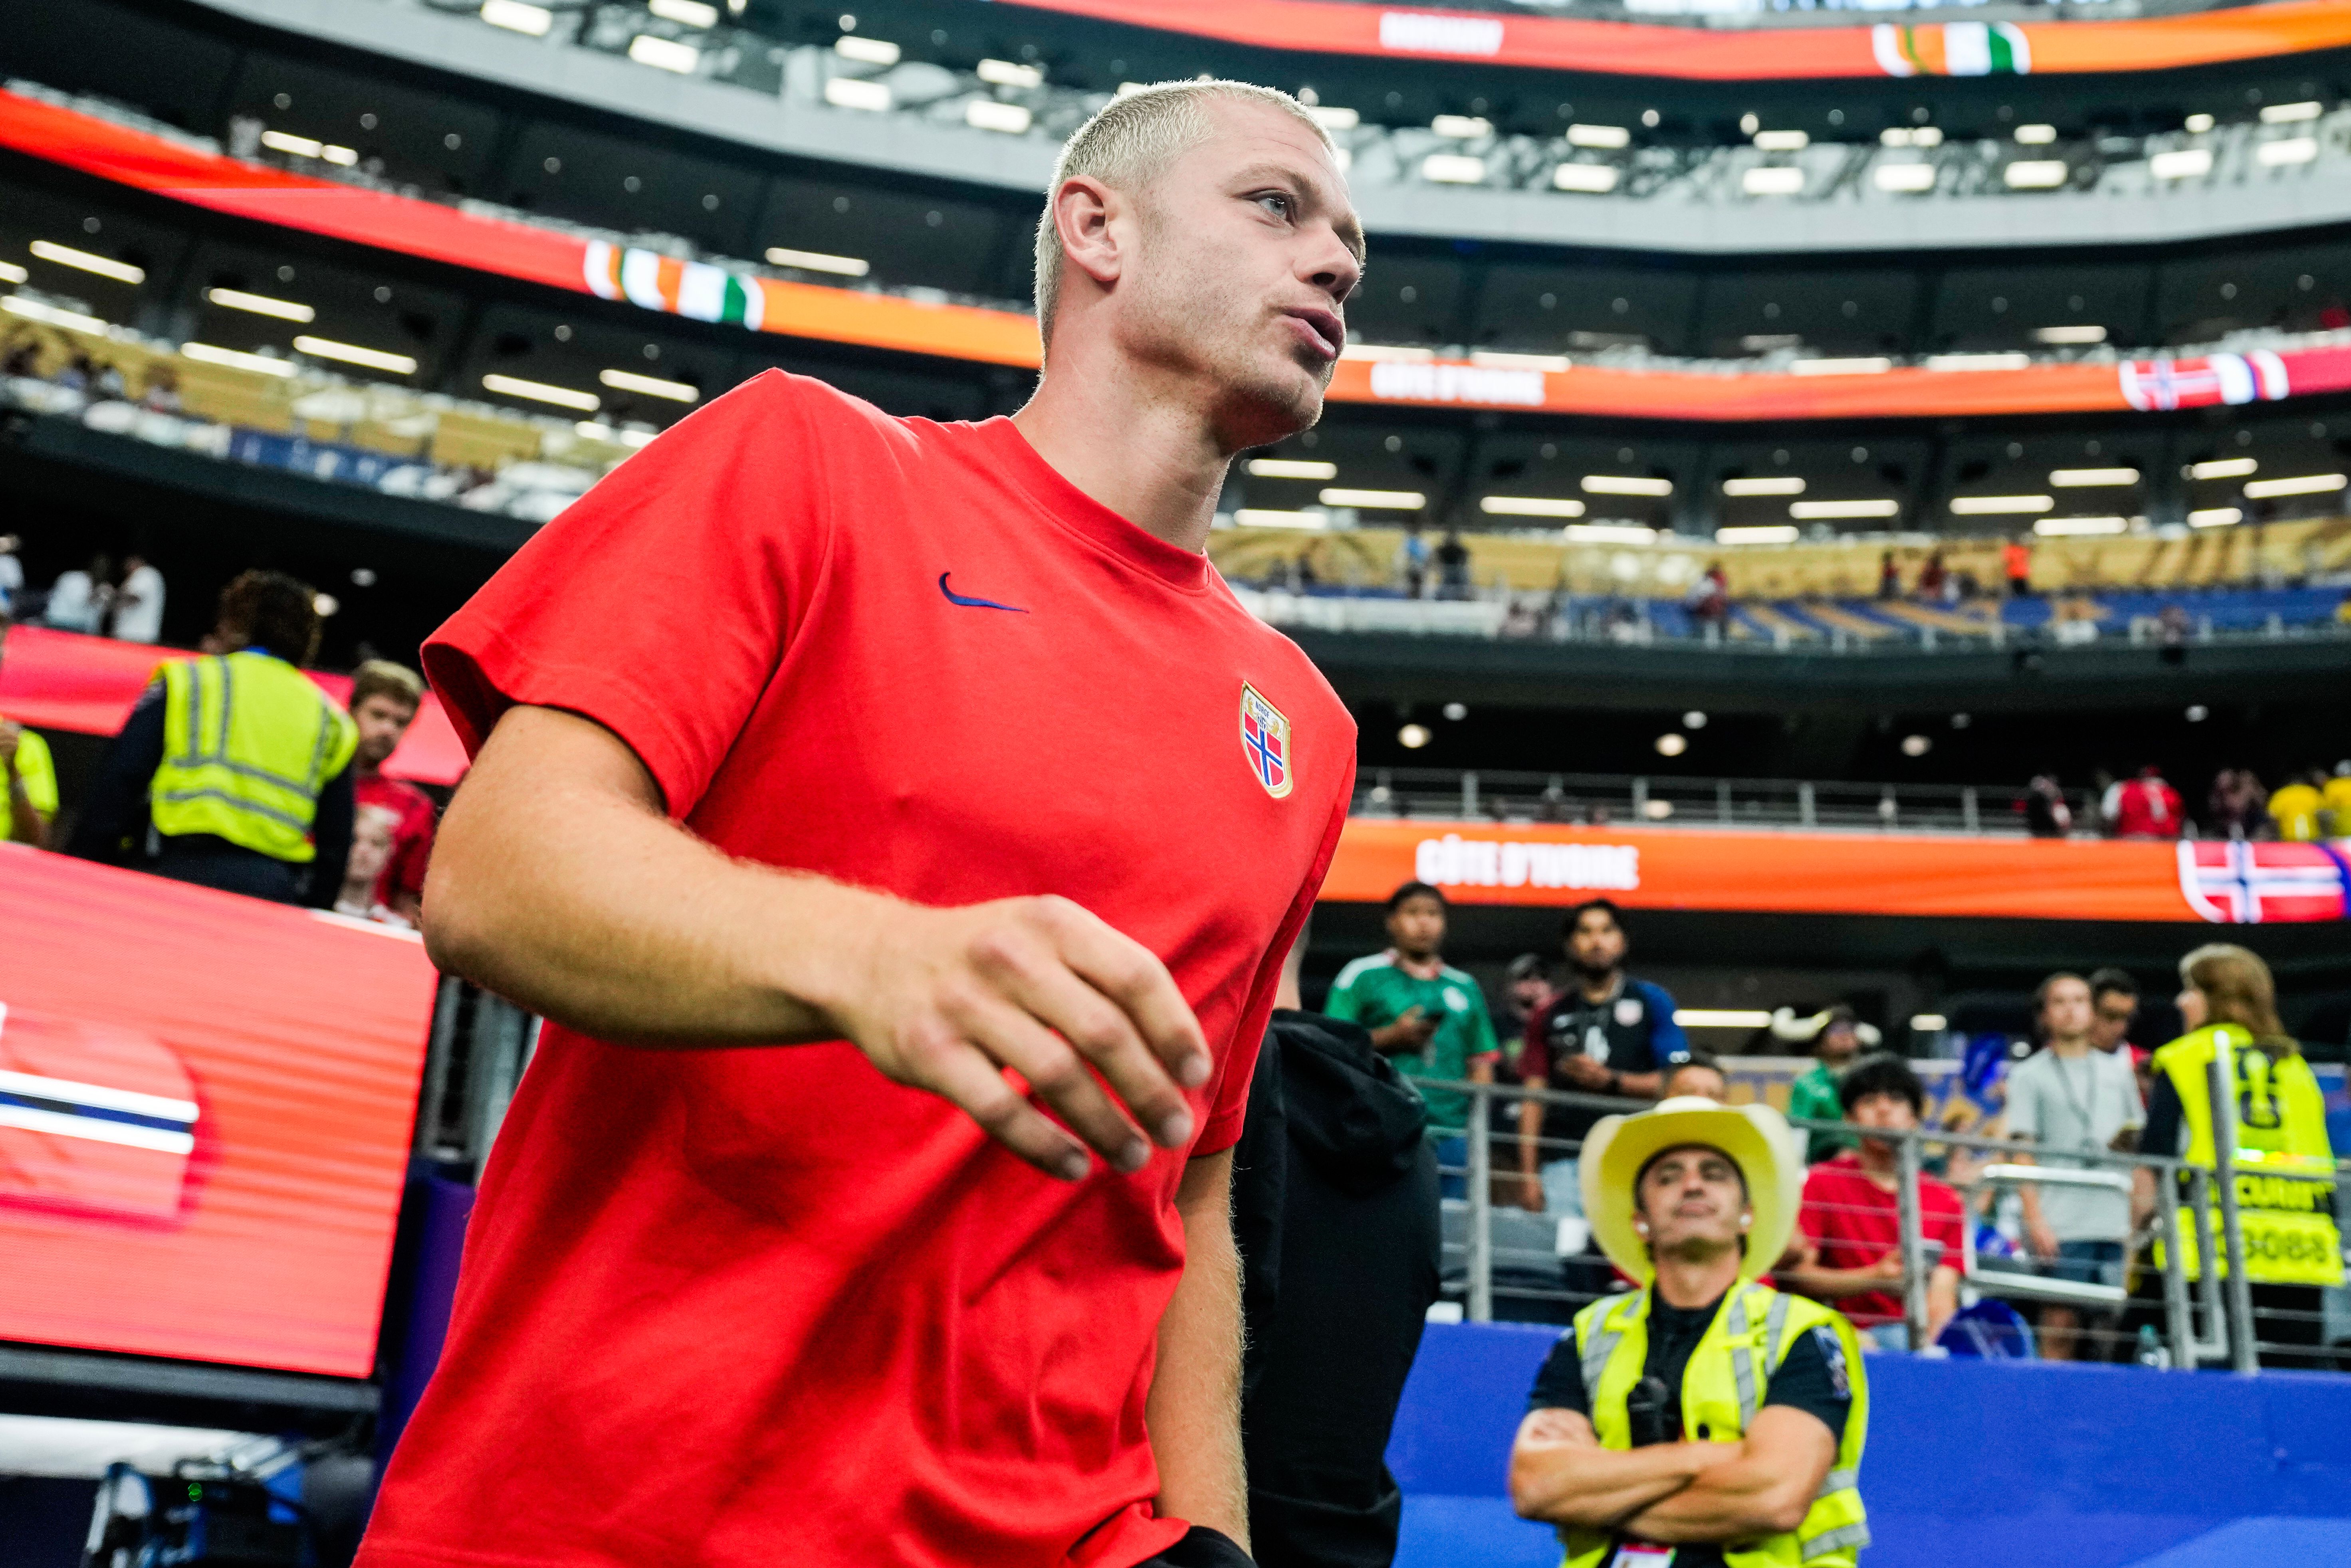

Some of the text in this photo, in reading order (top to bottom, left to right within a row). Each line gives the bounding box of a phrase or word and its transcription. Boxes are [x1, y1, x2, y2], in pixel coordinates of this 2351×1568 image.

[1256, 701, 1269, 719] NORGE
[1258, 715, 1267, 729] NFF
[1416, 833, 1499, 886] CÔTE
